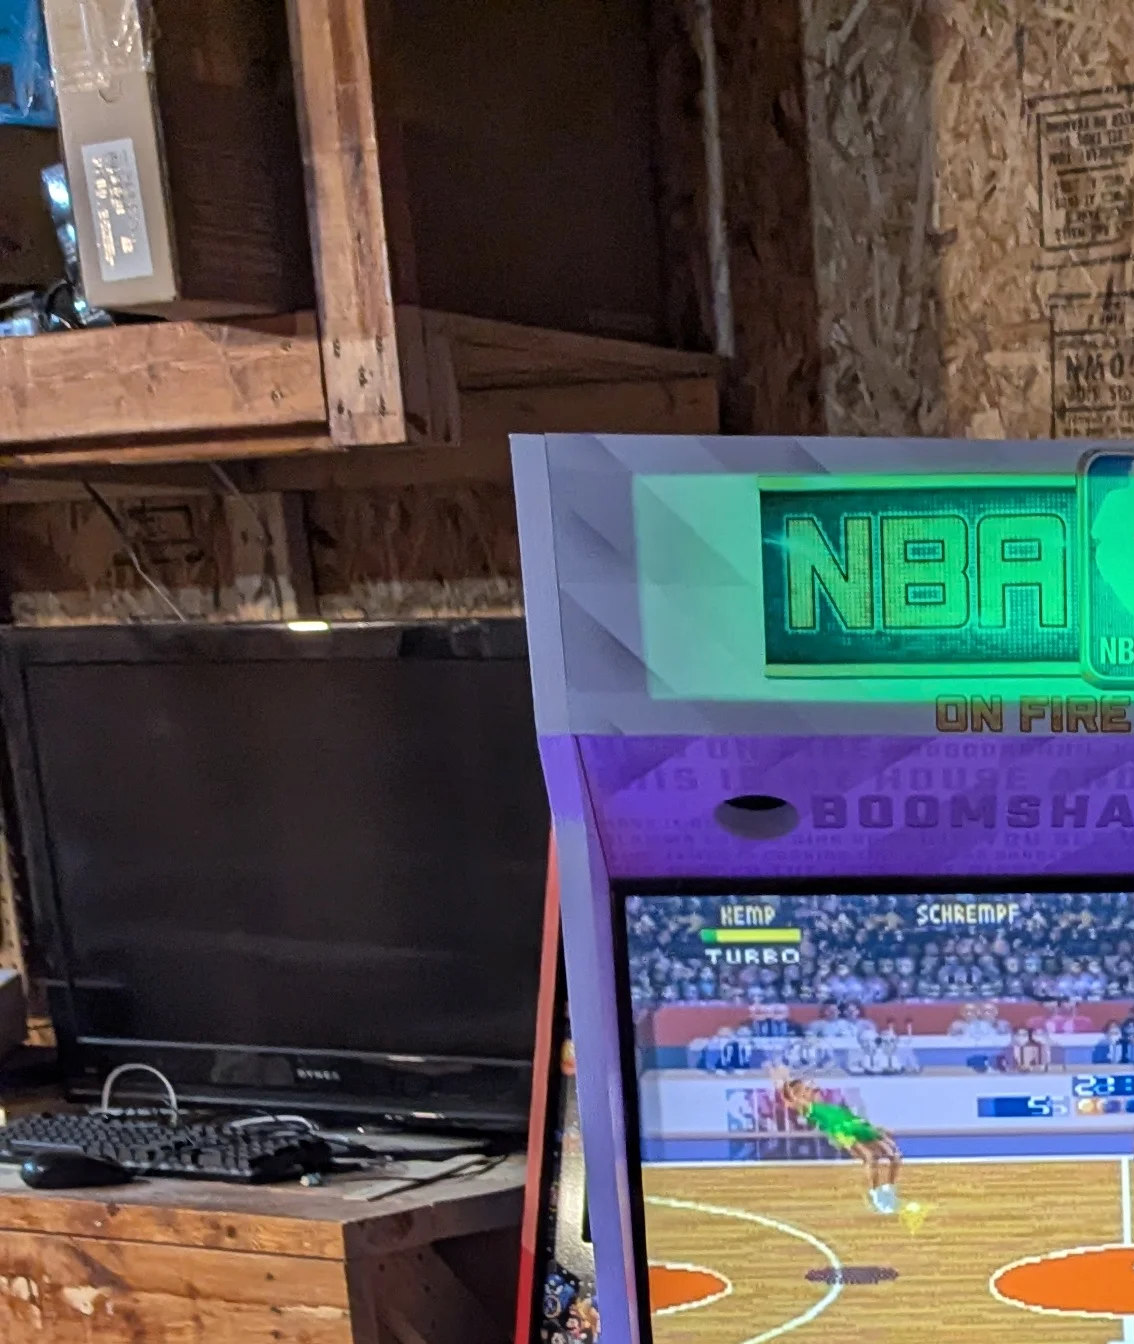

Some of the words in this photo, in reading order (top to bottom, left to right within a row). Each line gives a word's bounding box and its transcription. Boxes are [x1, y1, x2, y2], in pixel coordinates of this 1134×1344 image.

[785, 511, 1069, 631] NBA
[935, 695, 1003, 733] ON
[1020, 695, 1131, 733] FIRE
[720, 905, 776, 926] KEMP
[916, 903, 1019, 926] SCHREMPF
[704, 947, 800, 965] TURBO
